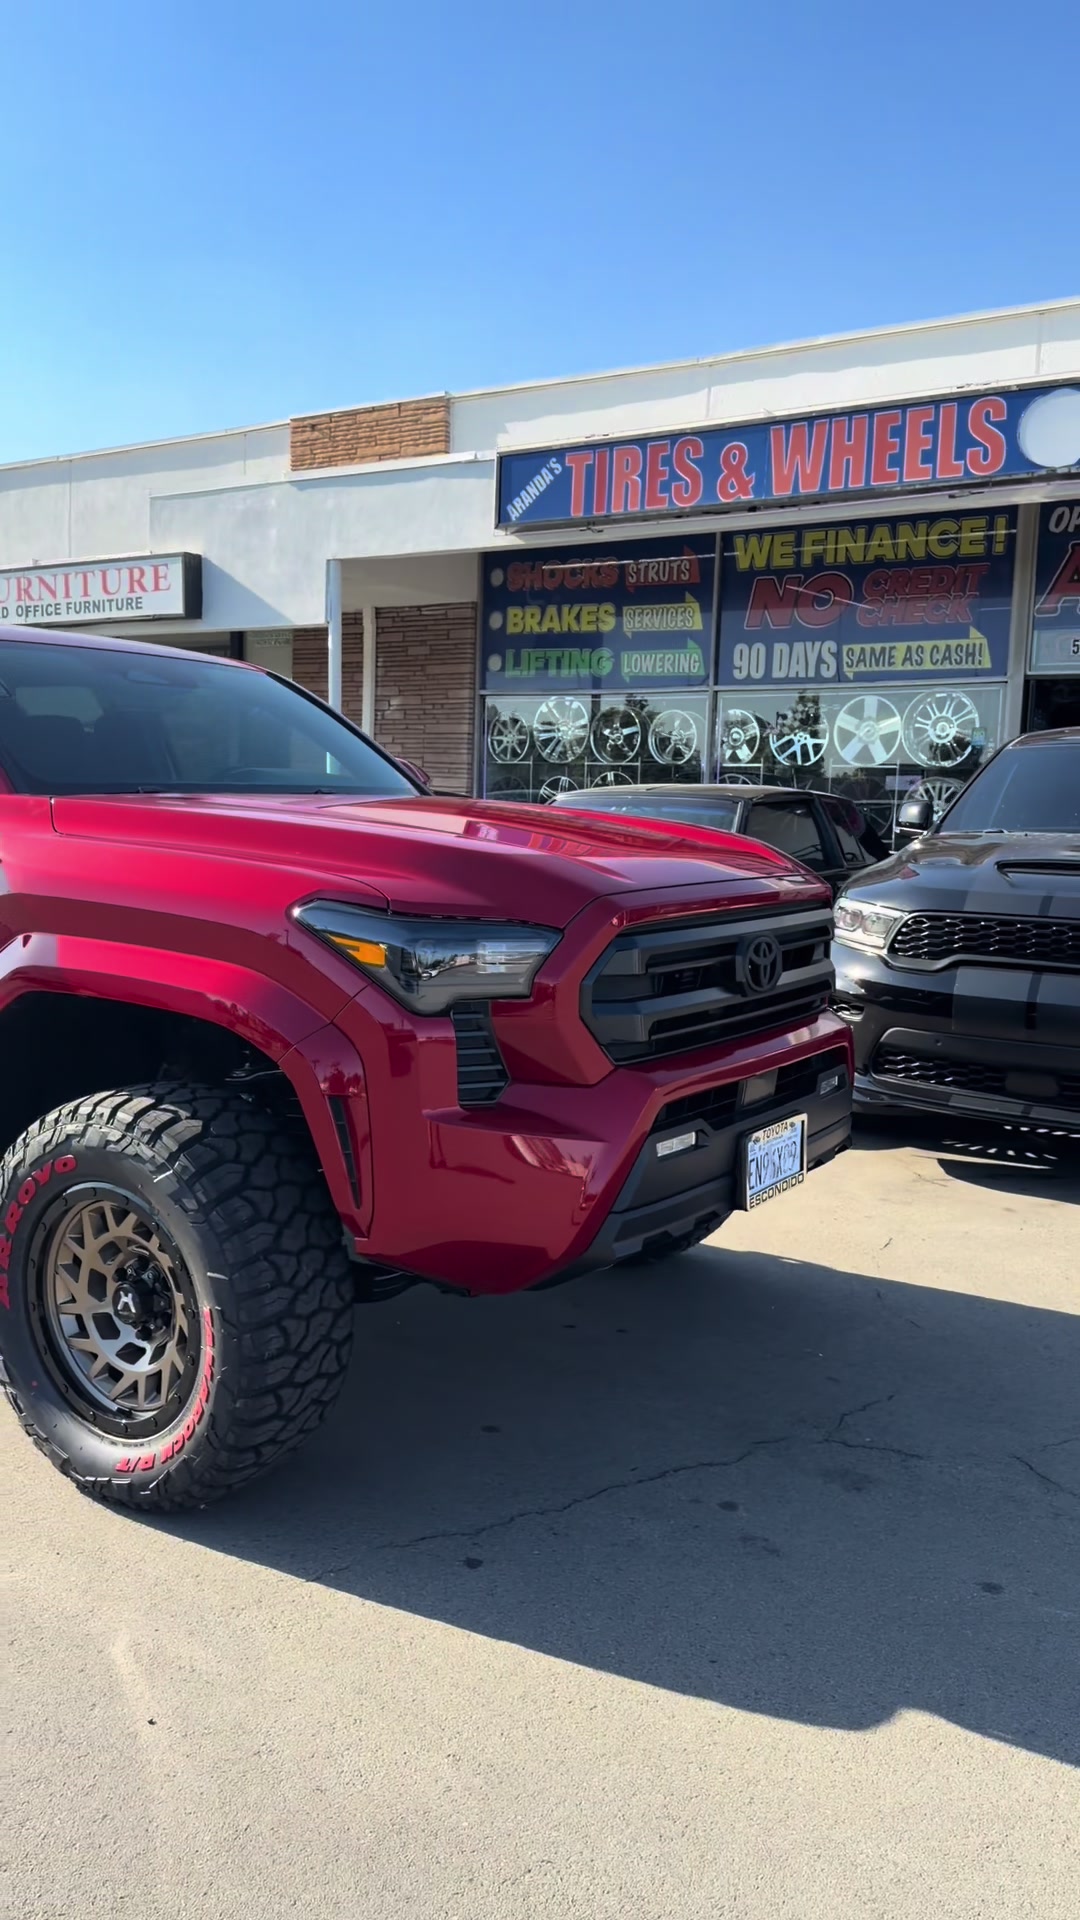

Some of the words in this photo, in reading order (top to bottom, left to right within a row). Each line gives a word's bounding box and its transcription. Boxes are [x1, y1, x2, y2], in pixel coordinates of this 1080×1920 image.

[565, 436, 704, 517] TIRES
[716, 441, 756, 502] &
[770, 396, 1007, 496] WHEELS
[507, 457, 562, 521] ARANDA'S
[734, 533, 797, 571] WE
[507, 557, 620, 592] SHOCKS
[628, 560, 691, 583] STRUTS
[16, 602, 62, 618] OFFICE
[66, 597, 144, 615] FURNITURE
[744, 571, 854, 630] NO
[863, 562, 991, 599] CREDIT
[856, 592, 980, 627] CHECK
[506, 602, 617, 634] BRAKES
[625, 606, 695, 630] SERVICES
[505, 648, 615, 678] LIFTING
[623, 653, 700, 675] LOWERING
[733, 643, 767, 680] 90
[771, 640, 838, 678] DAYS
[845, 644, 897, 669] SAME
[902, 644, 924, 667] AS
[929, 641, 984, 666] CASH!
[762, 1121, 788, 1140] TOYOTA
[750, 1172, 805, 1209] ESCONDIDO
